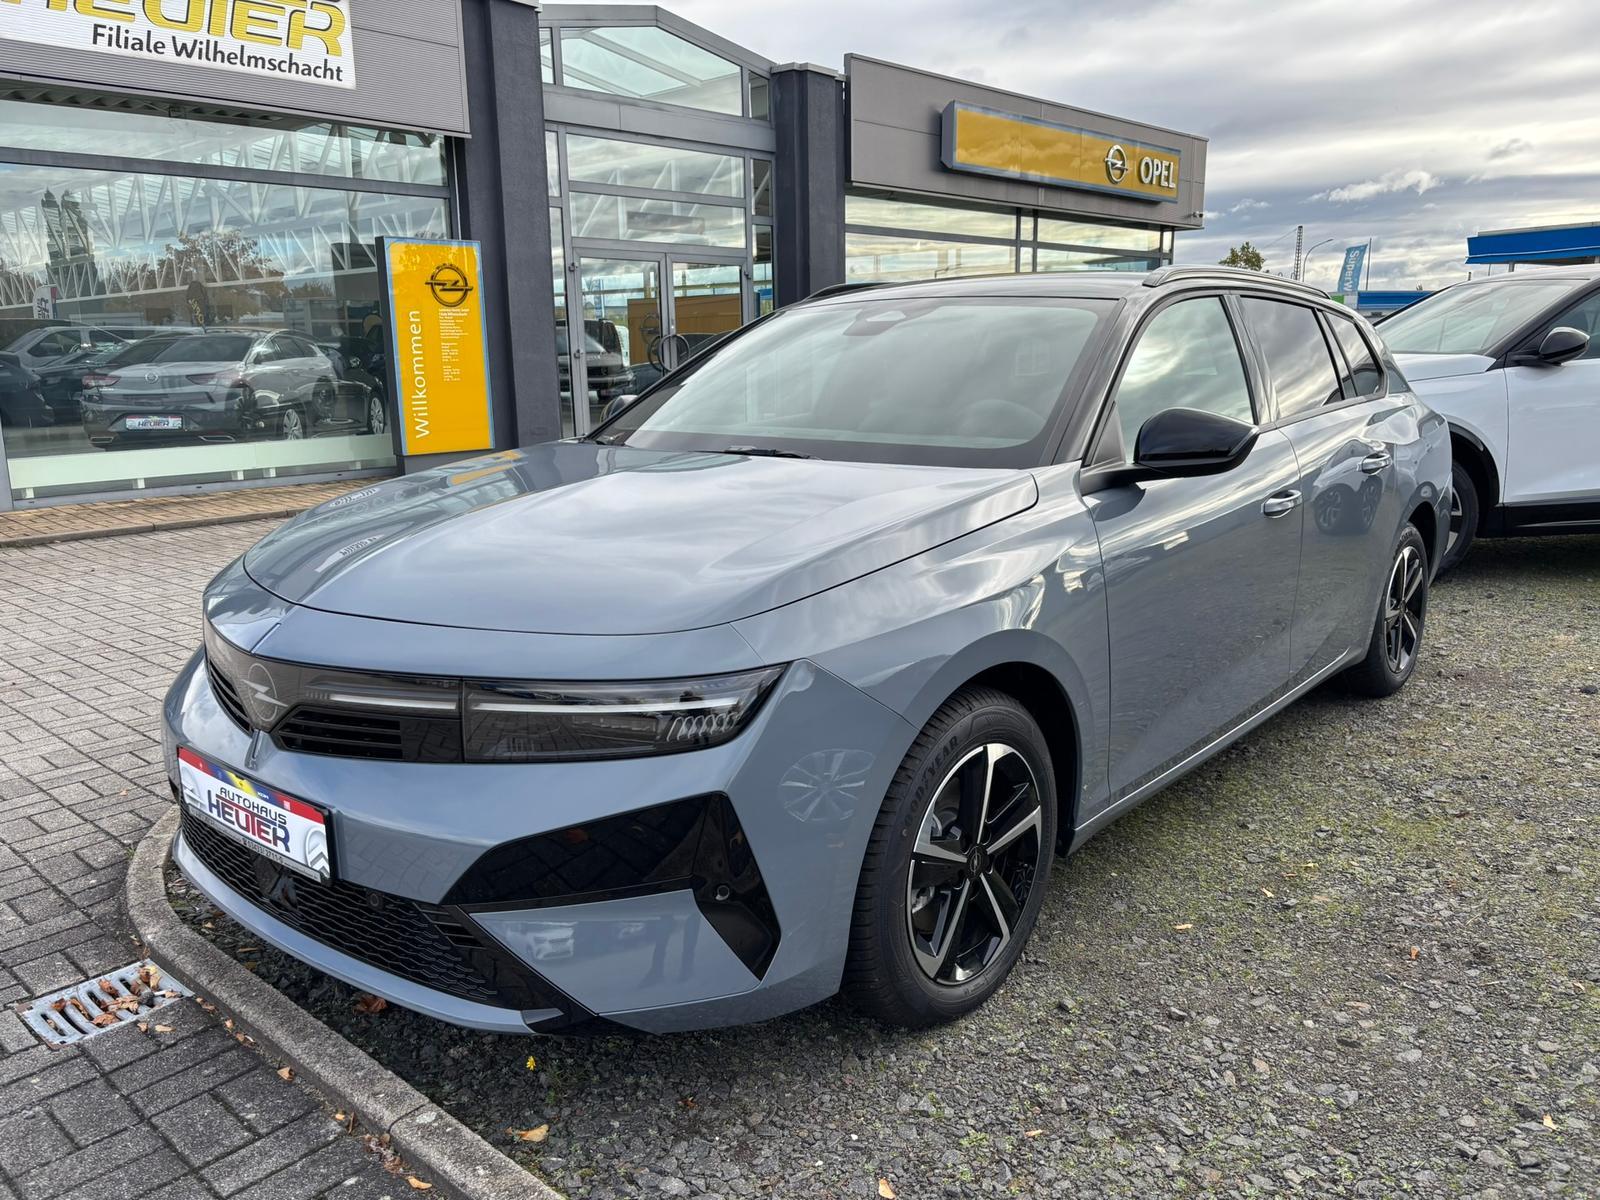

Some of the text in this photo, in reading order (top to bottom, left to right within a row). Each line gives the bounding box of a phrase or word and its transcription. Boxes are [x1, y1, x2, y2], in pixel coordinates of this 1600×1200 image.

[0, 0, 346, 57] UTER
[92, 23, 343, 82] Filiale Wilhelmschacht
[1139, 156, 1176, 189] OPEL
[408, 310, 431, 439] Willkommen
[207, 789, 291, 853] HEUTER
[219, 786, 287, 826] AUTOHAUS
